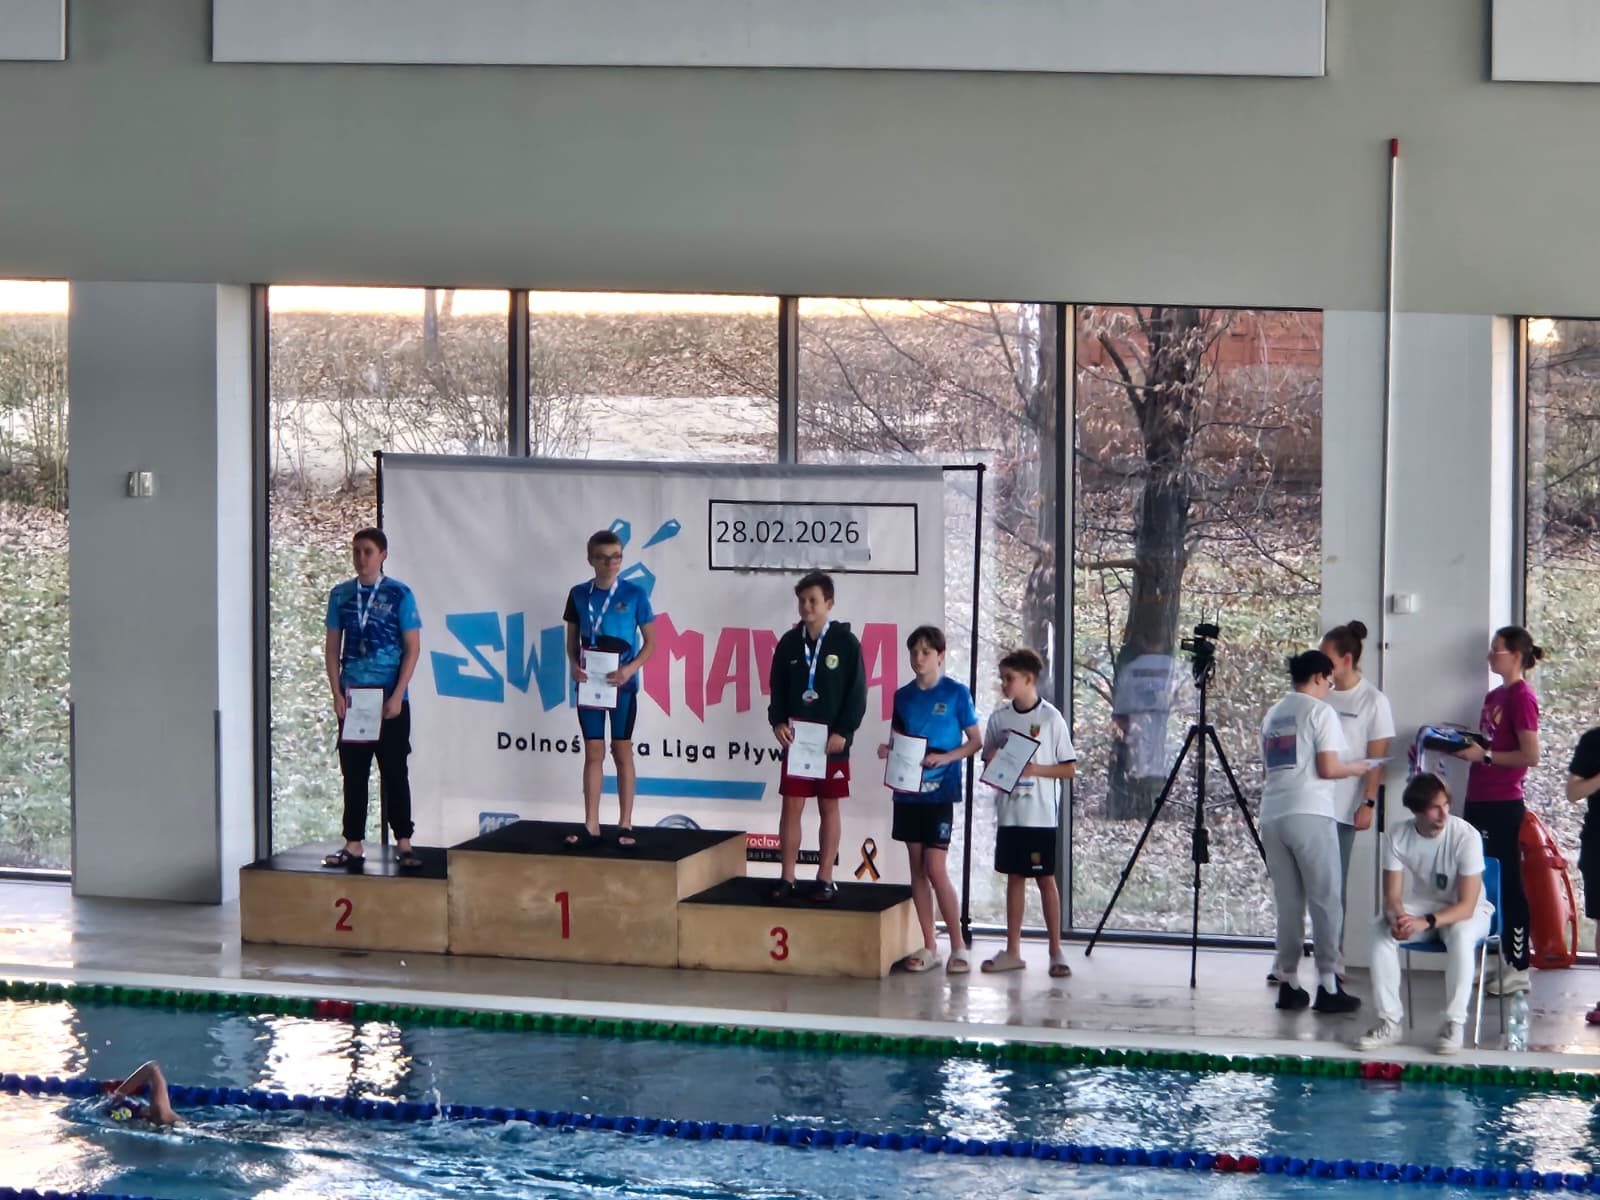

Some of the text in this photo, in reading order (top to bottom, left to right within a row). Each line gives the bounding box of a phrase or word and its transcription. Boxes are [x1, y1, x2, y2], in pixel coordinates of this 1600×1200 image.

[716, 520, 860, 544] 28.02.2026
[497, 732, 650, 756] Dolnośa
[663, 739, 715, 763] Liga
[728, 742, 785, 765] Pływ
[334, 898, 353, 932] 2
[554, 891, 570, 940] 1
[769, 926, 789, 961] 3
